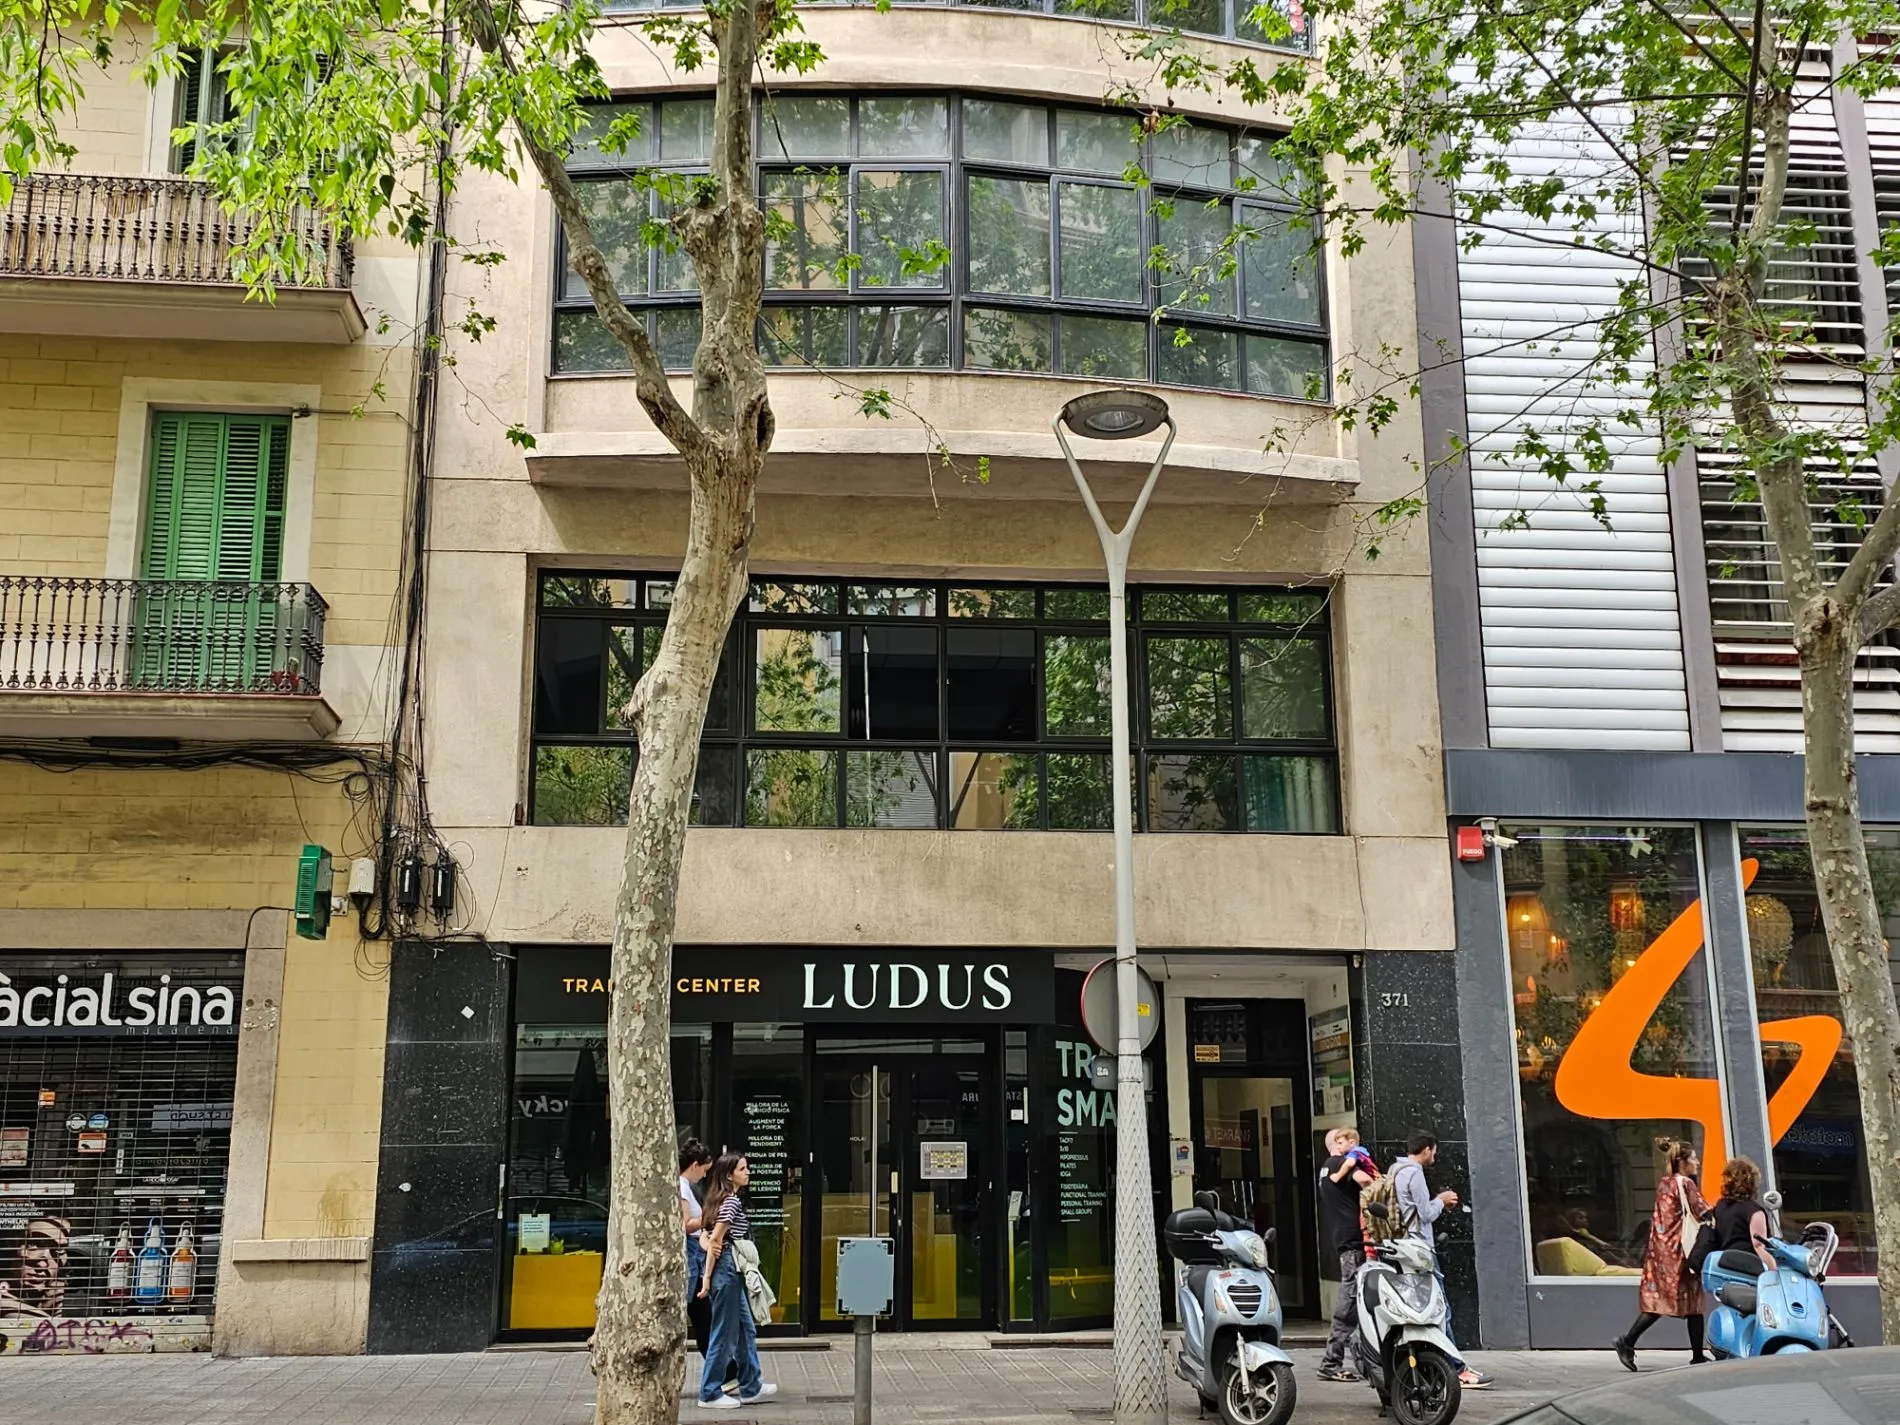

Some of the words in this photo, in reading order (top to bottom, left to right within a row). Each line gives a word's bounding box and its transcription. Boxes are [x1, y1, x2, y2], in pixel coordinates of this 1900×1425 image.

[676, 978, 761, 993] CENTER
[803, 963, 1012, 1010] LUDUS
[1381, 992, 1409, 1007] 371
[126, 1026, 233, 1035] macarena
